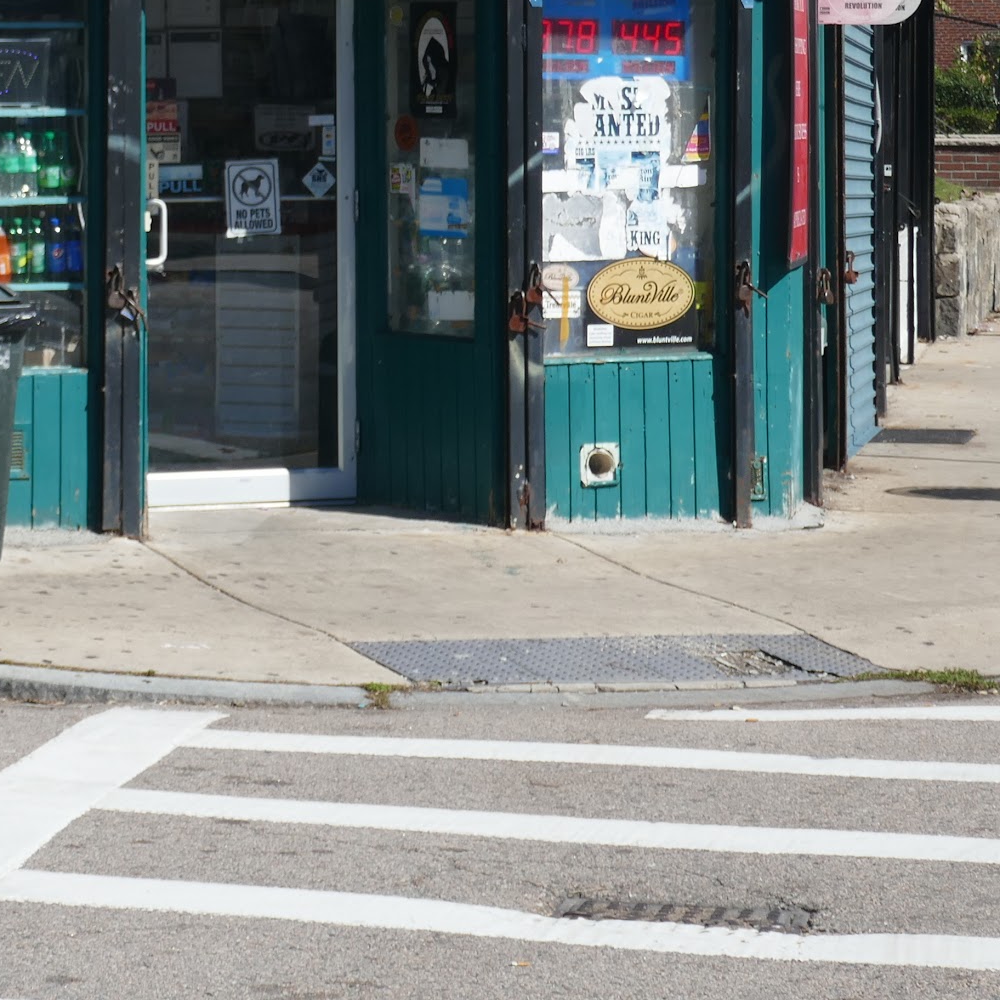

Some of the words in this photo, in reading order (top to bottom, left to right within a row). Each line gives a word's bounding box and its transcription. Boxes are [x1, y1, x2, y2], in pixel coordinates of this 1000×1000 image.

[620, 20, 683, 55] 445
[146, 121, 177, 132] PULL
[158, 179, 202, 193] PULL
[236, 209, 247, 219] NO
[249, 208, 271, 219] PETS
[234, 218, 273, 230] ALLOWED
[630, 231, 661, 247] KING
[630, 311, 654, 320] CIGAR
[636, 335, 693, 344] www.bluntville.com
